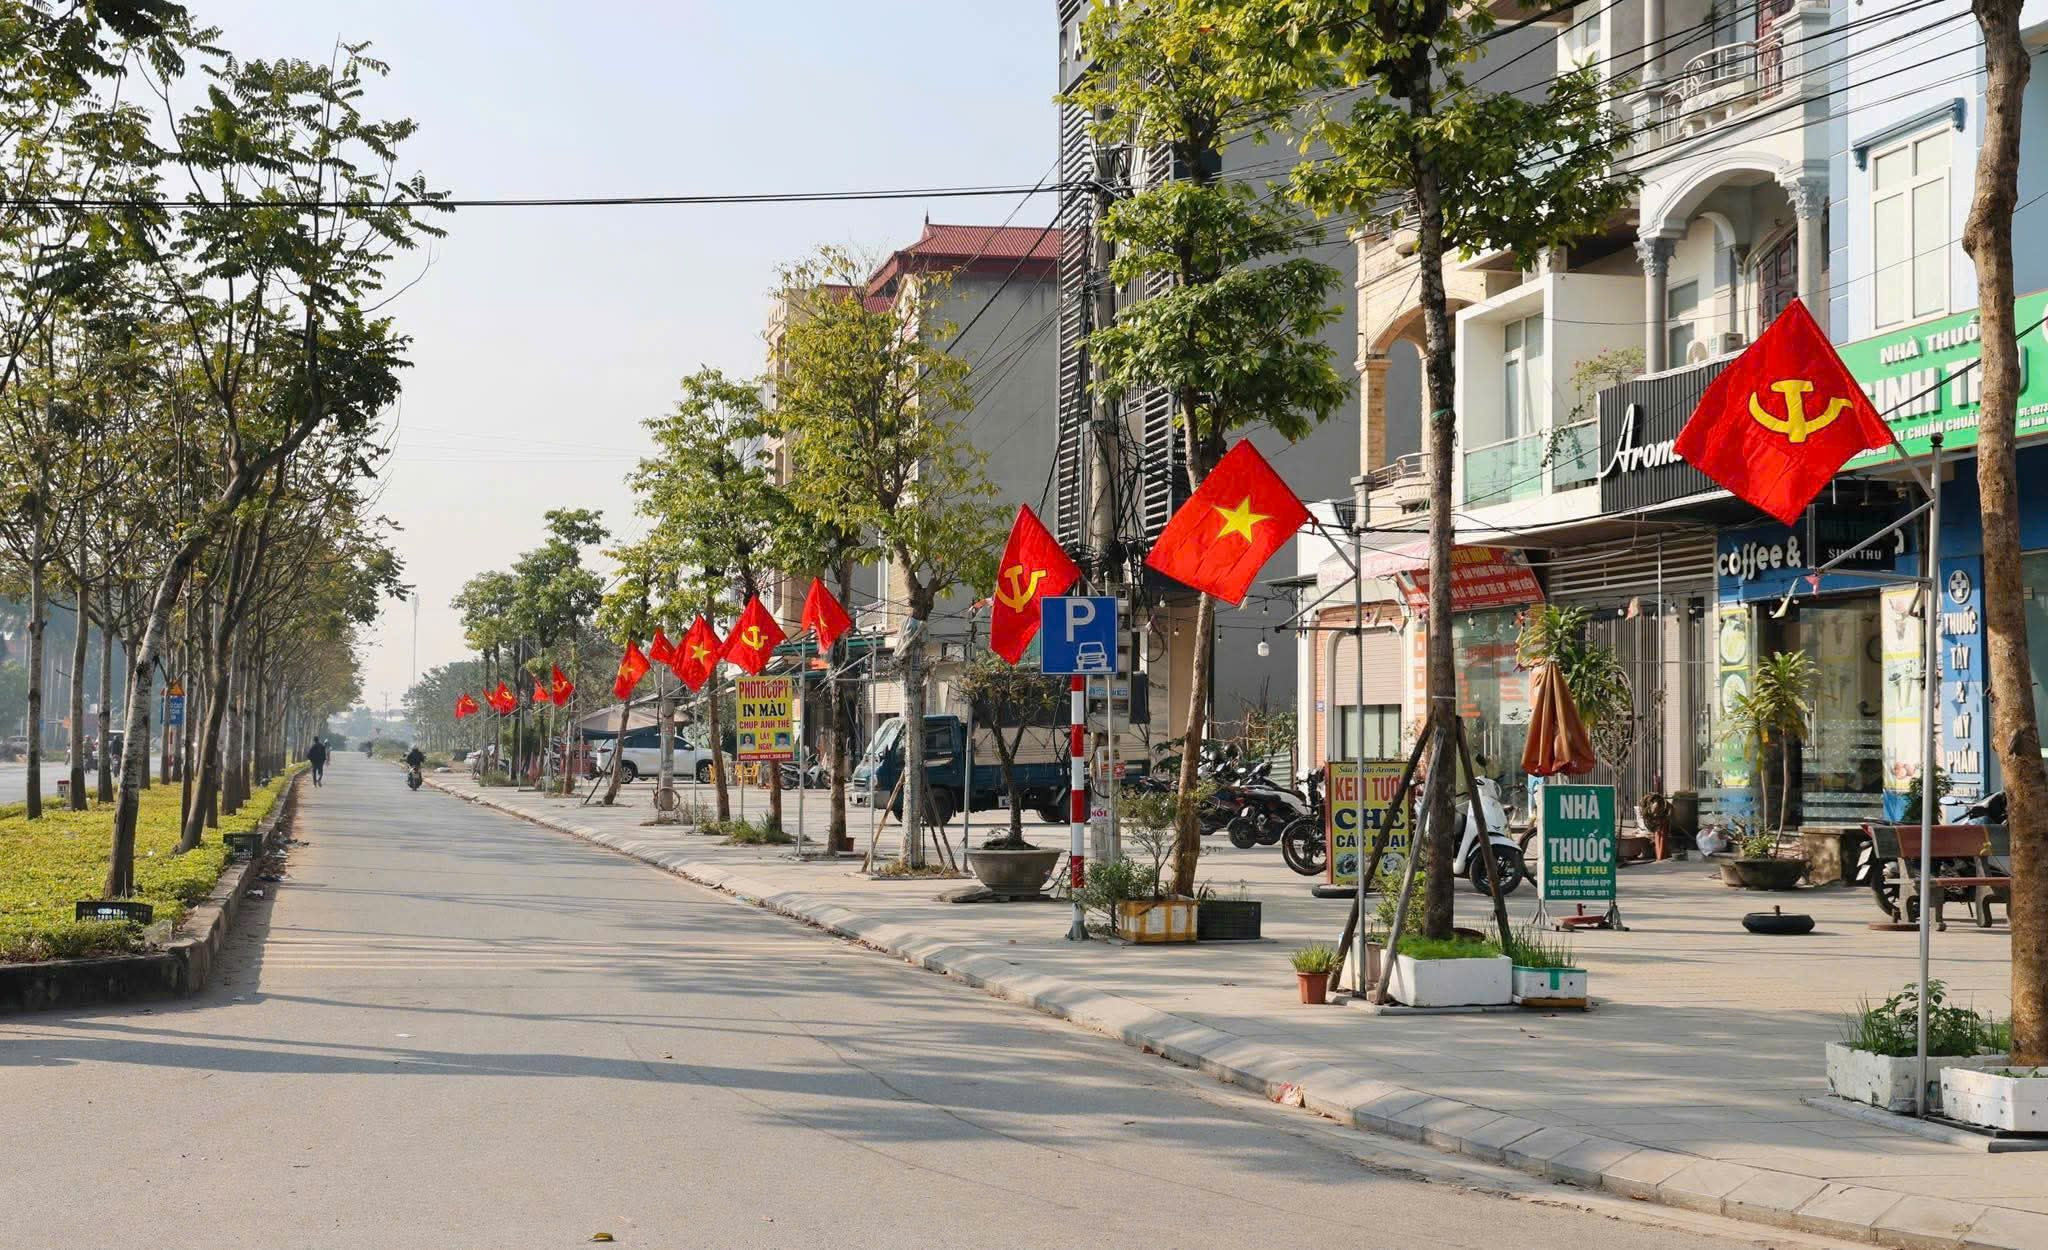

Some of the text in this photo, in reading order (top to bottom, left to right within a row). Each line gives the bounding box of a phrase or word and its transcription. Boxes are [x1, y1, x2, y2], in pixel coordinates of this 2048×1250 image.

[1881, 335, 1920, 365] NHÀ
[1596, 403, 1683, 478] Arom
[1718, 536, 1801, 581] coffee &
[1066, 598, 1096, 642] P
[1943, 606, 1978, 635] THUỐC
[1951, 643, 1970, 670] TÂY
[739, 680, 789, 699] PHOTOCOPY
[743, 700, 786, 717] IN MÀU
[1560, 790, 1600, 820] NHÀ
[1549, 829, 1611, 863] THUỐC
[1552, 865, 1608, 875] SINH THU
